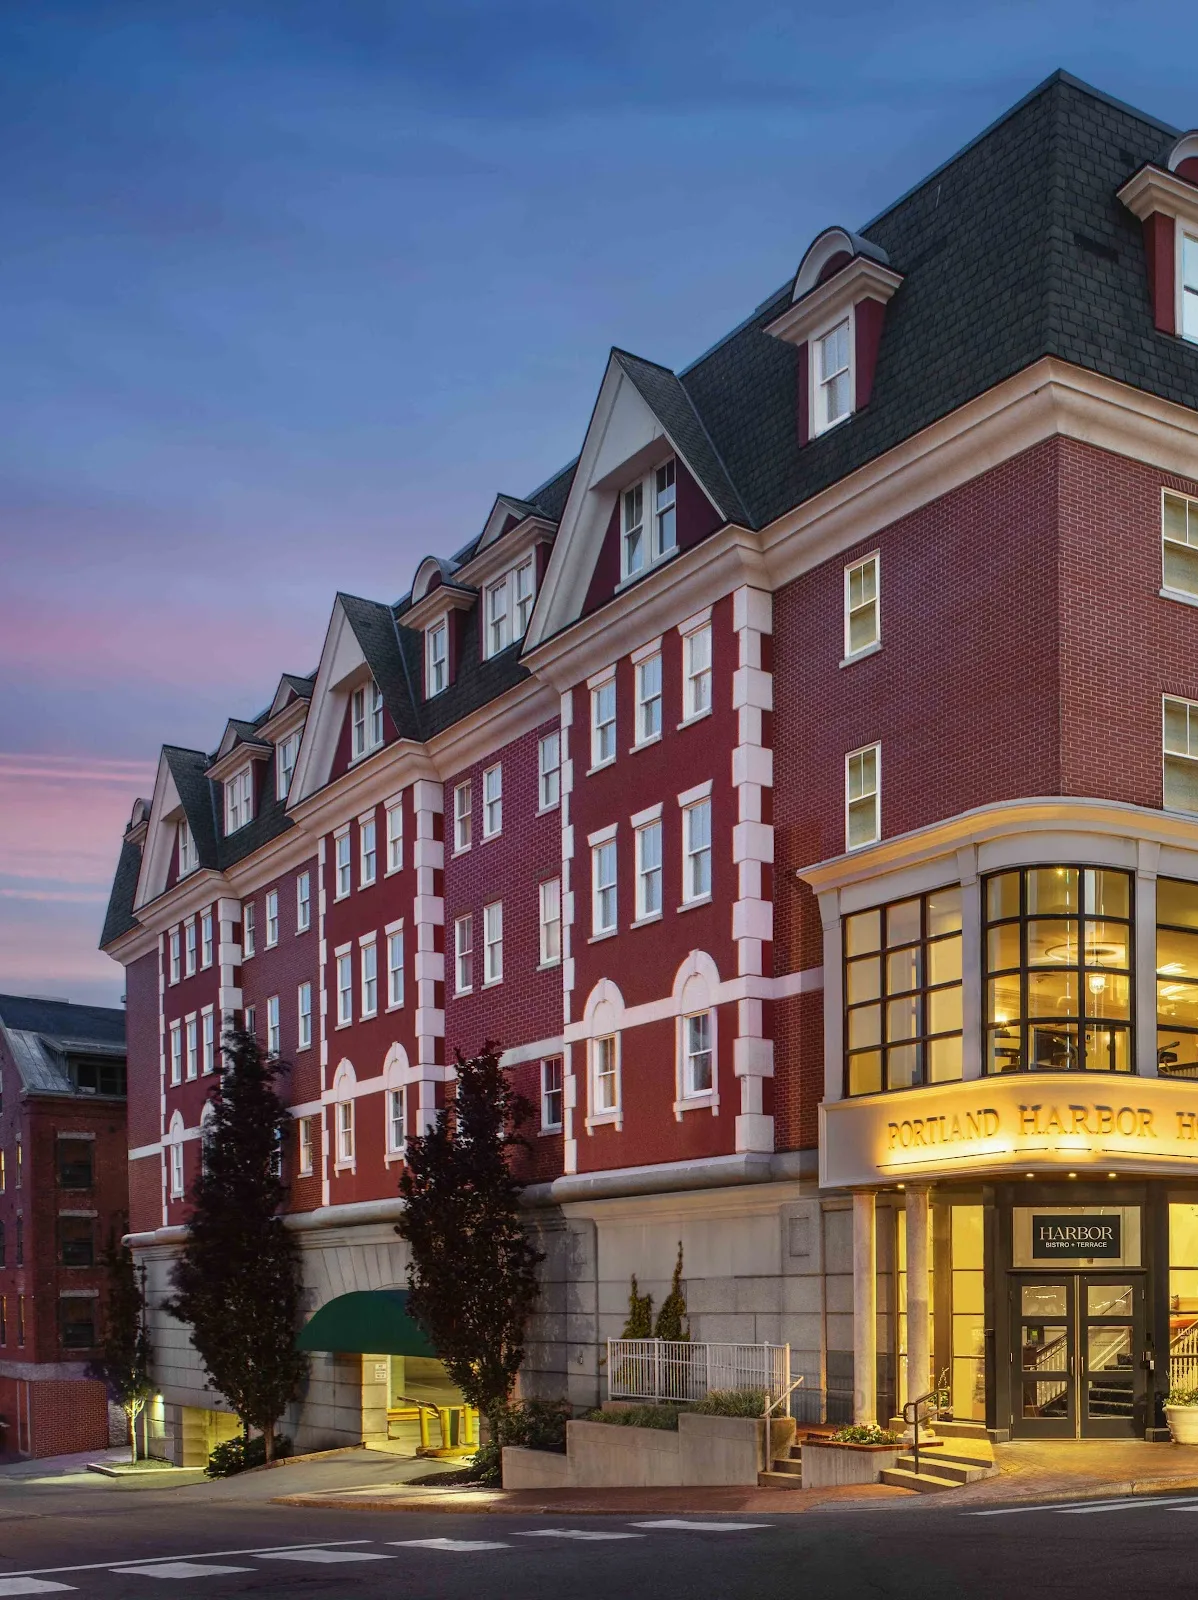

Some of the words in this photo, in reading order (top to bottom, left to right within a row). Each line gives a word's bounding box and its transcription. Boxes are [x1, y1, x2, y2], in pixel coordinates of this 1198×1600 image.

[888, 1108, 1000, 1150] PORTLAND
[1018, 1103, 1158, 1137] HARBOR
[1040, 1226, 1113, 1240] HARBOR
